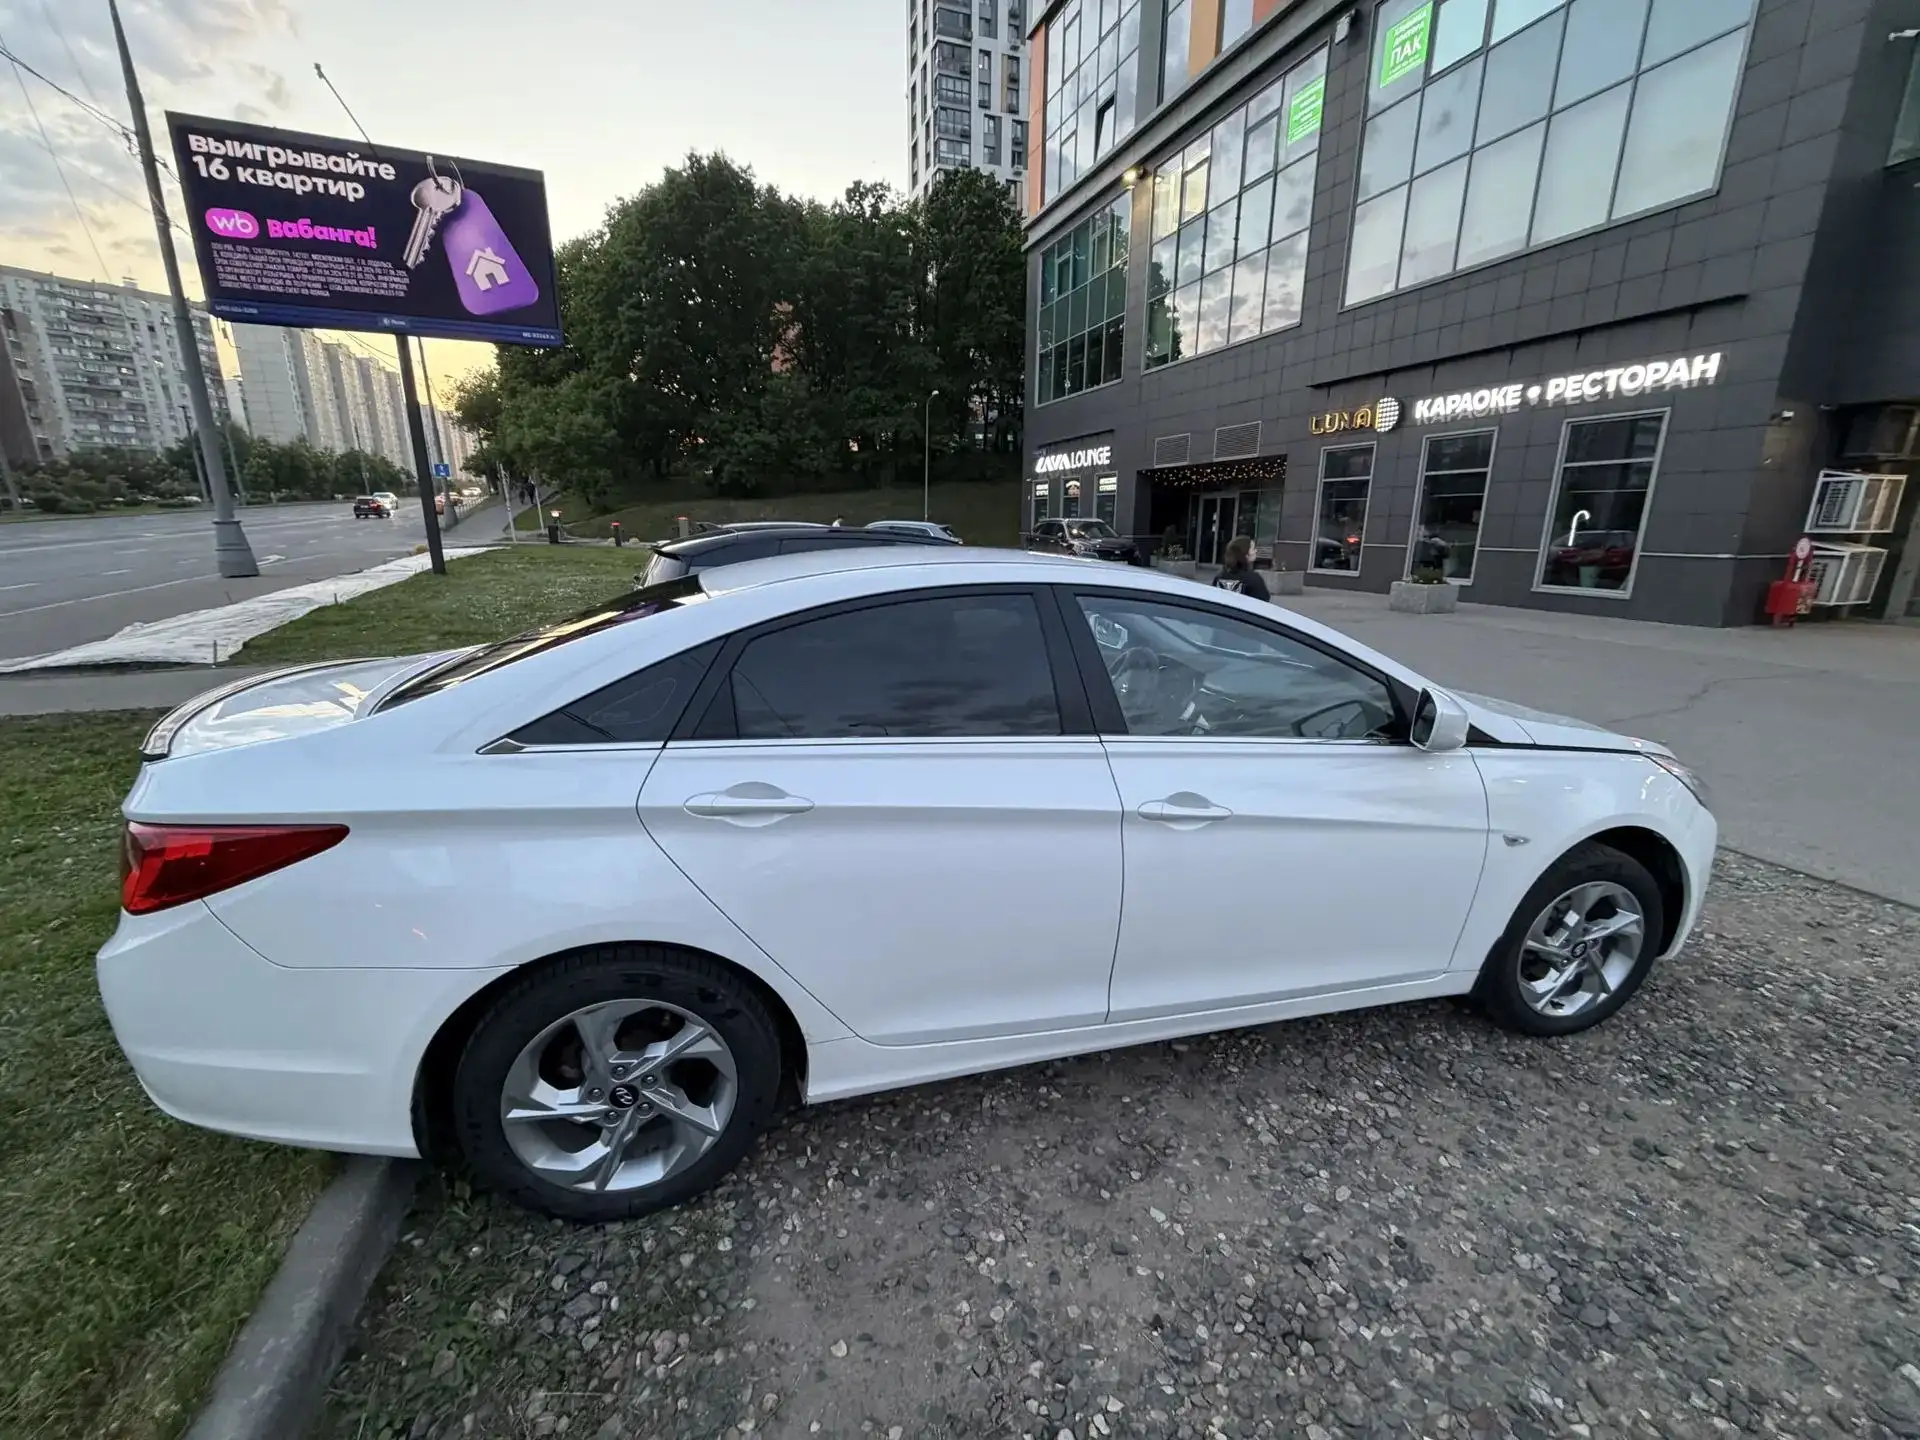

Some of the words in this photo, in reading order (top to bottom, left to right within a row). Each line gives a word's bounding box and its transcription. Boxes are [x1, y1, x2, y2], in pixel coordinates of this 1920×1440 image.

[1390, 32, 1424, 68] ПАК
[192, 155, 230, 180] 16
[236, 166, 366, 202] квартир
[212, 213, 254, 233] wb
[267, 218, 378, 249] вабанга!
[1415, 384, 1524, 419] КАРАОКЕ
[1546, 352, 1721, 400] РЕСТОРАН
[1309, 407, 1371, 434] LUNA
[1071, 445, 1112, 469] LOUNGE
